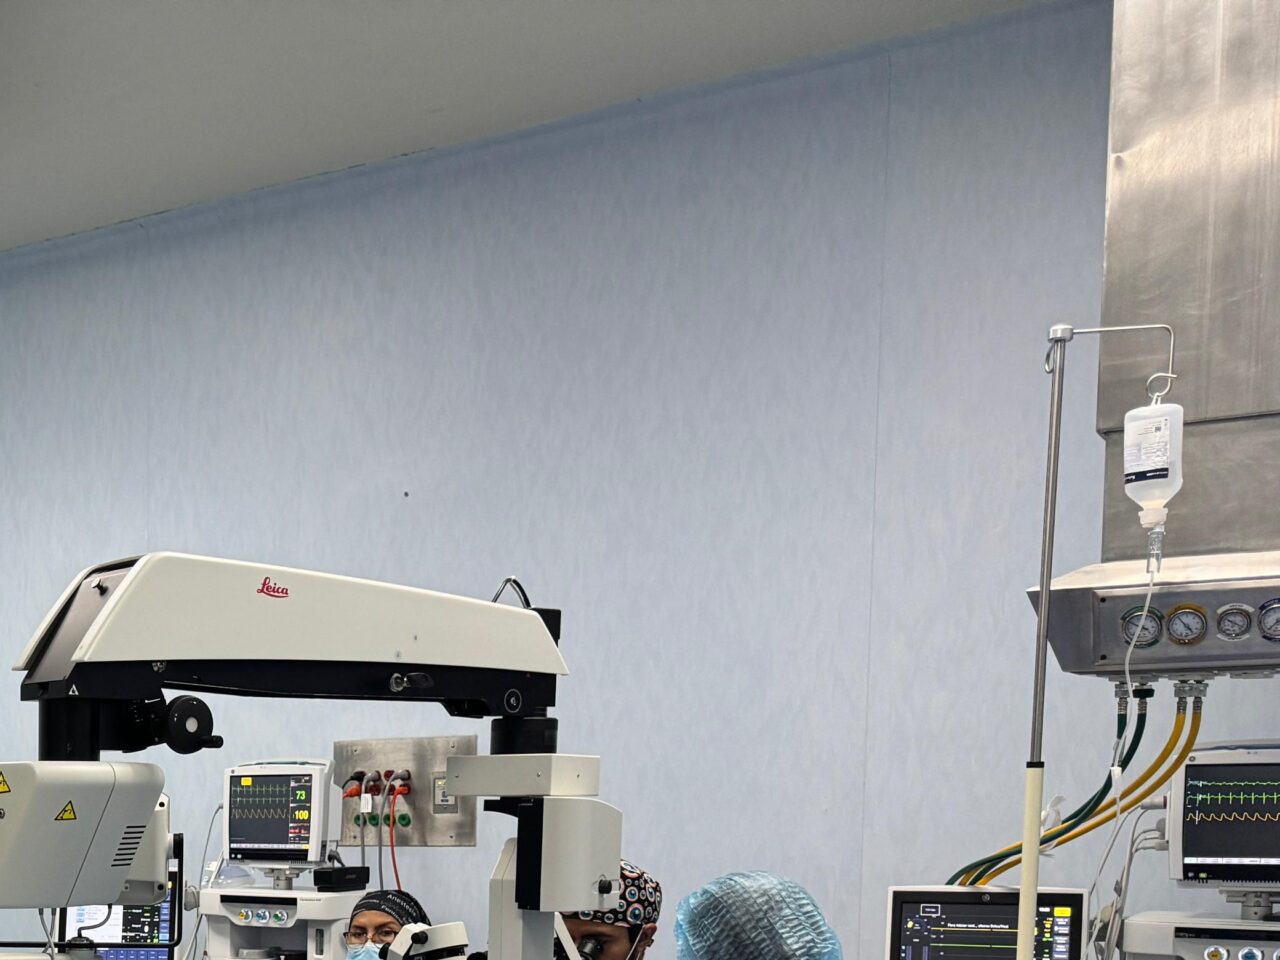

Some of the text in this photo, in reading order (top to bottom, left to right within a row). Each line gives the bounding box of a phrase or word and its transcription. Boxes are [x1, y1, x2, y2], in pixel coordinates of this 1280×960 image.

[256, 576, 289, 599] Leica
[295, 790, 306, 800] 73
[294, 810, 309, 820] 100
